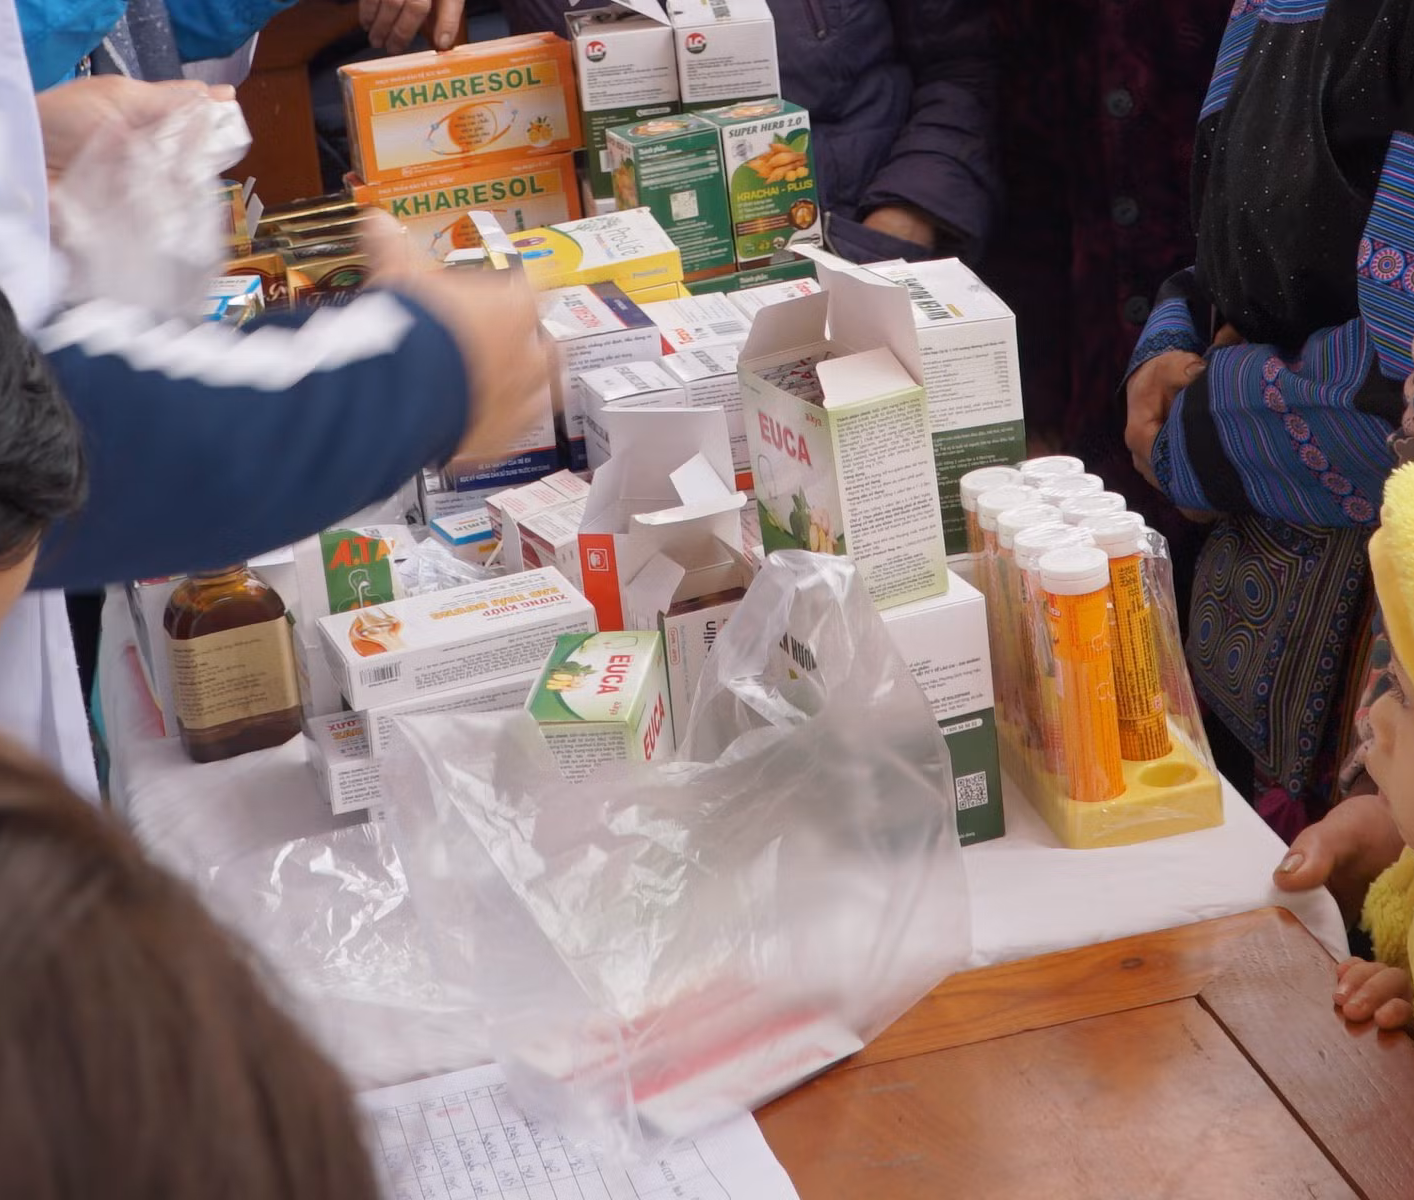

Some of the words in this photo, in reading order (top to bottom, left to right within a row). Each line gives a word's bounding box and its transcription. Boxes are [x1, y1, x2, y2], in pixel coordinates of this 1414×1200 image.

[389, 67, 541, 108] KHARESOL
[729, 126, 758, 138] SUPER
[761, 120, 785, 132] HERB
[787, 118, 803, 128] 2.0
[391, 176, 544, 217] KHARESOL
[787, 179, 814, 193] PLUS
[758, 410, 812, 468] EUCA
[597, 654, 633, 695] EUCA
[643, 693, 665, 761] EUCA
